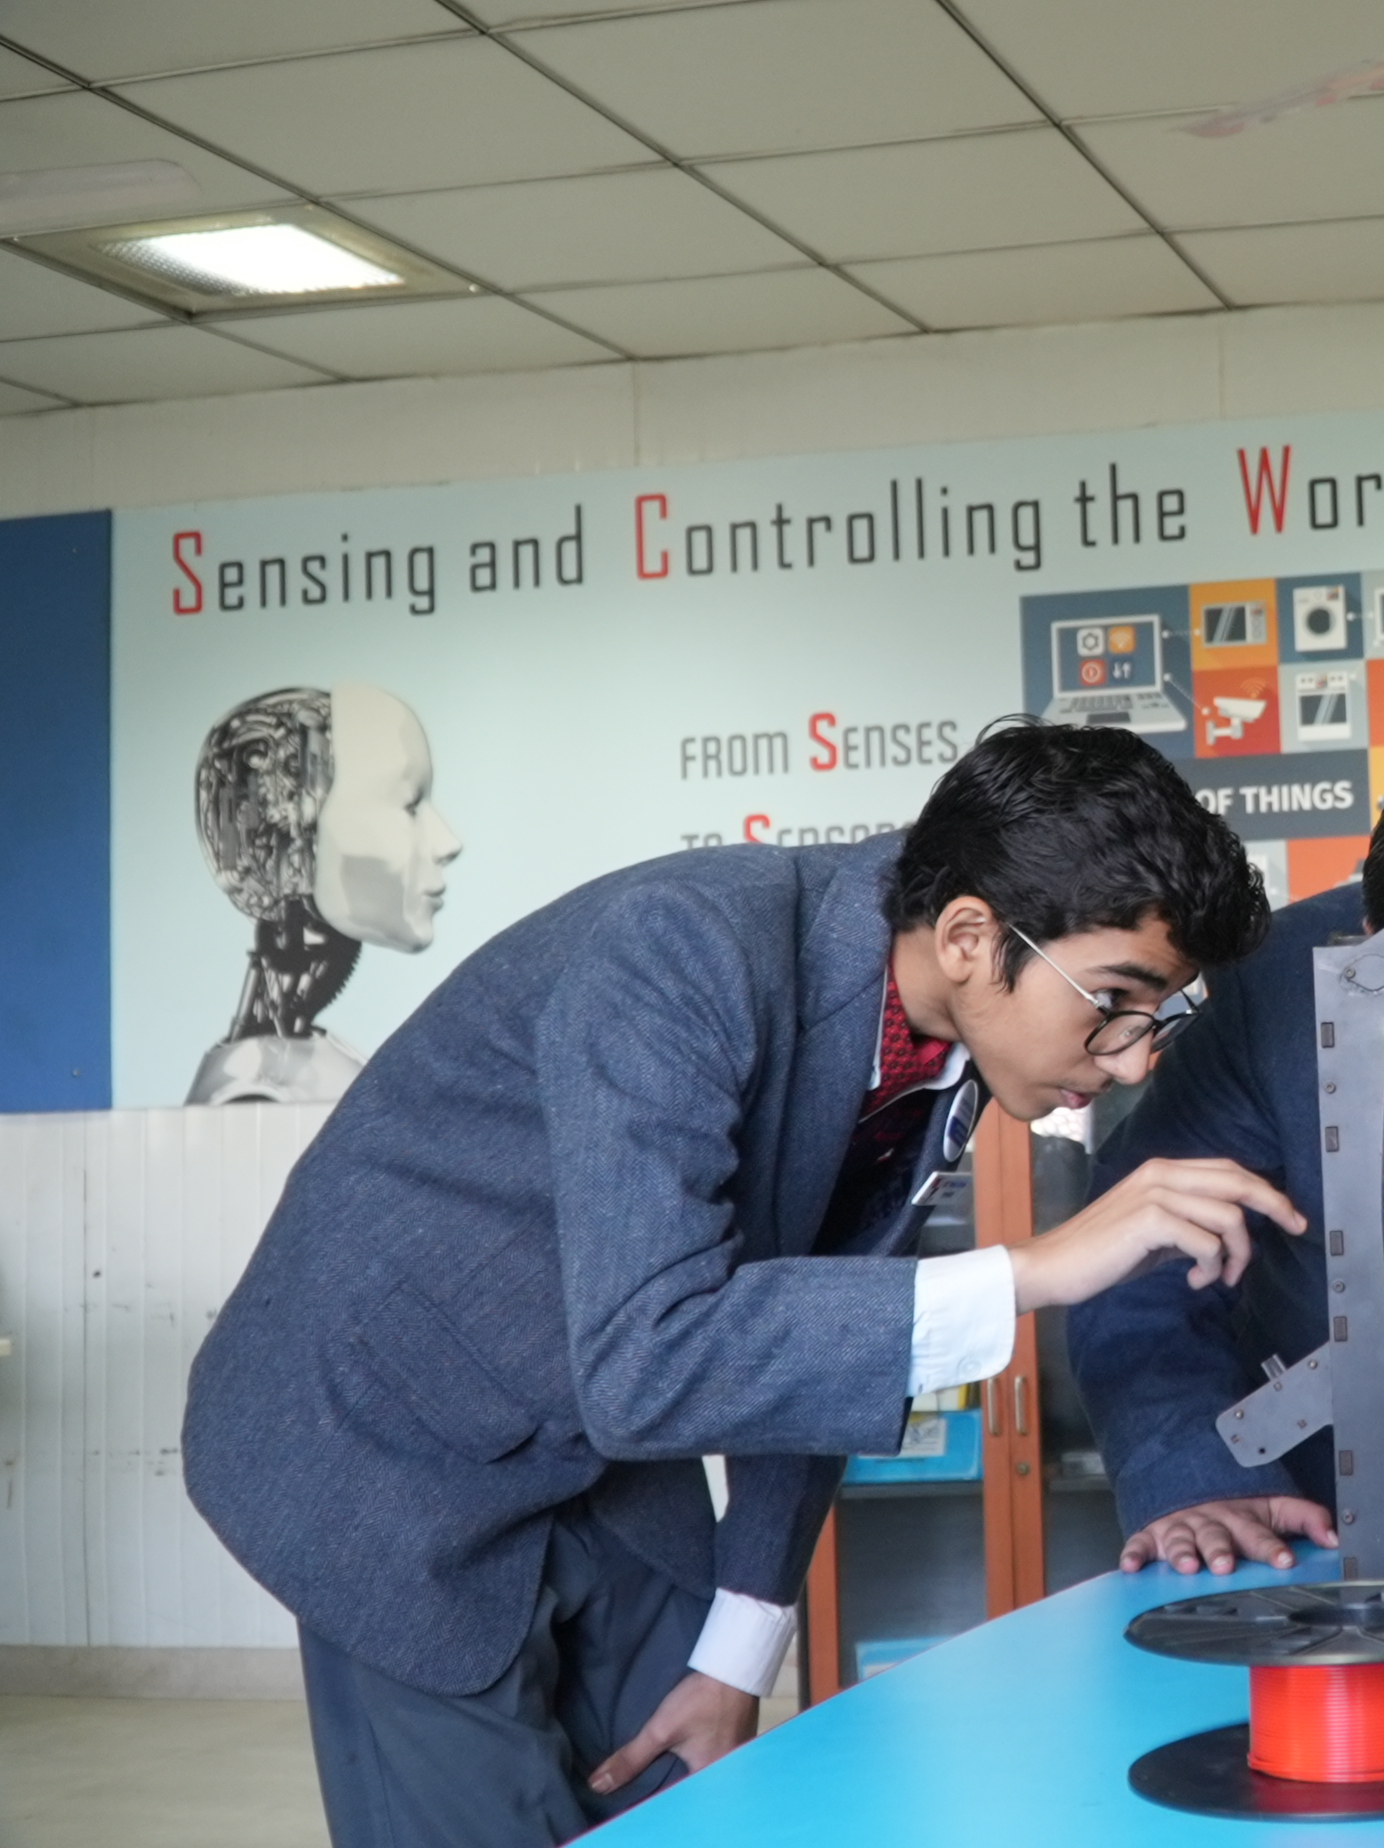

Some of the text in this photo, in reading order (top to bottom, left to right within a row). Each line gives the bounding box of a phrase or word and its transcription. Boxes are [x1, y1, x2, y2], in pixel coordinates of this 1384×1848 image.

[171, 529, 437, 617] Sensing
[468, 503, 585, 593] and
[635, 477, 1043, 581] Controlling
[1073, 463, 1187, 548] the
[680, 711, 960, 780] FROM SENSES
[1195, 780, 1354, 816] OF THINGS
